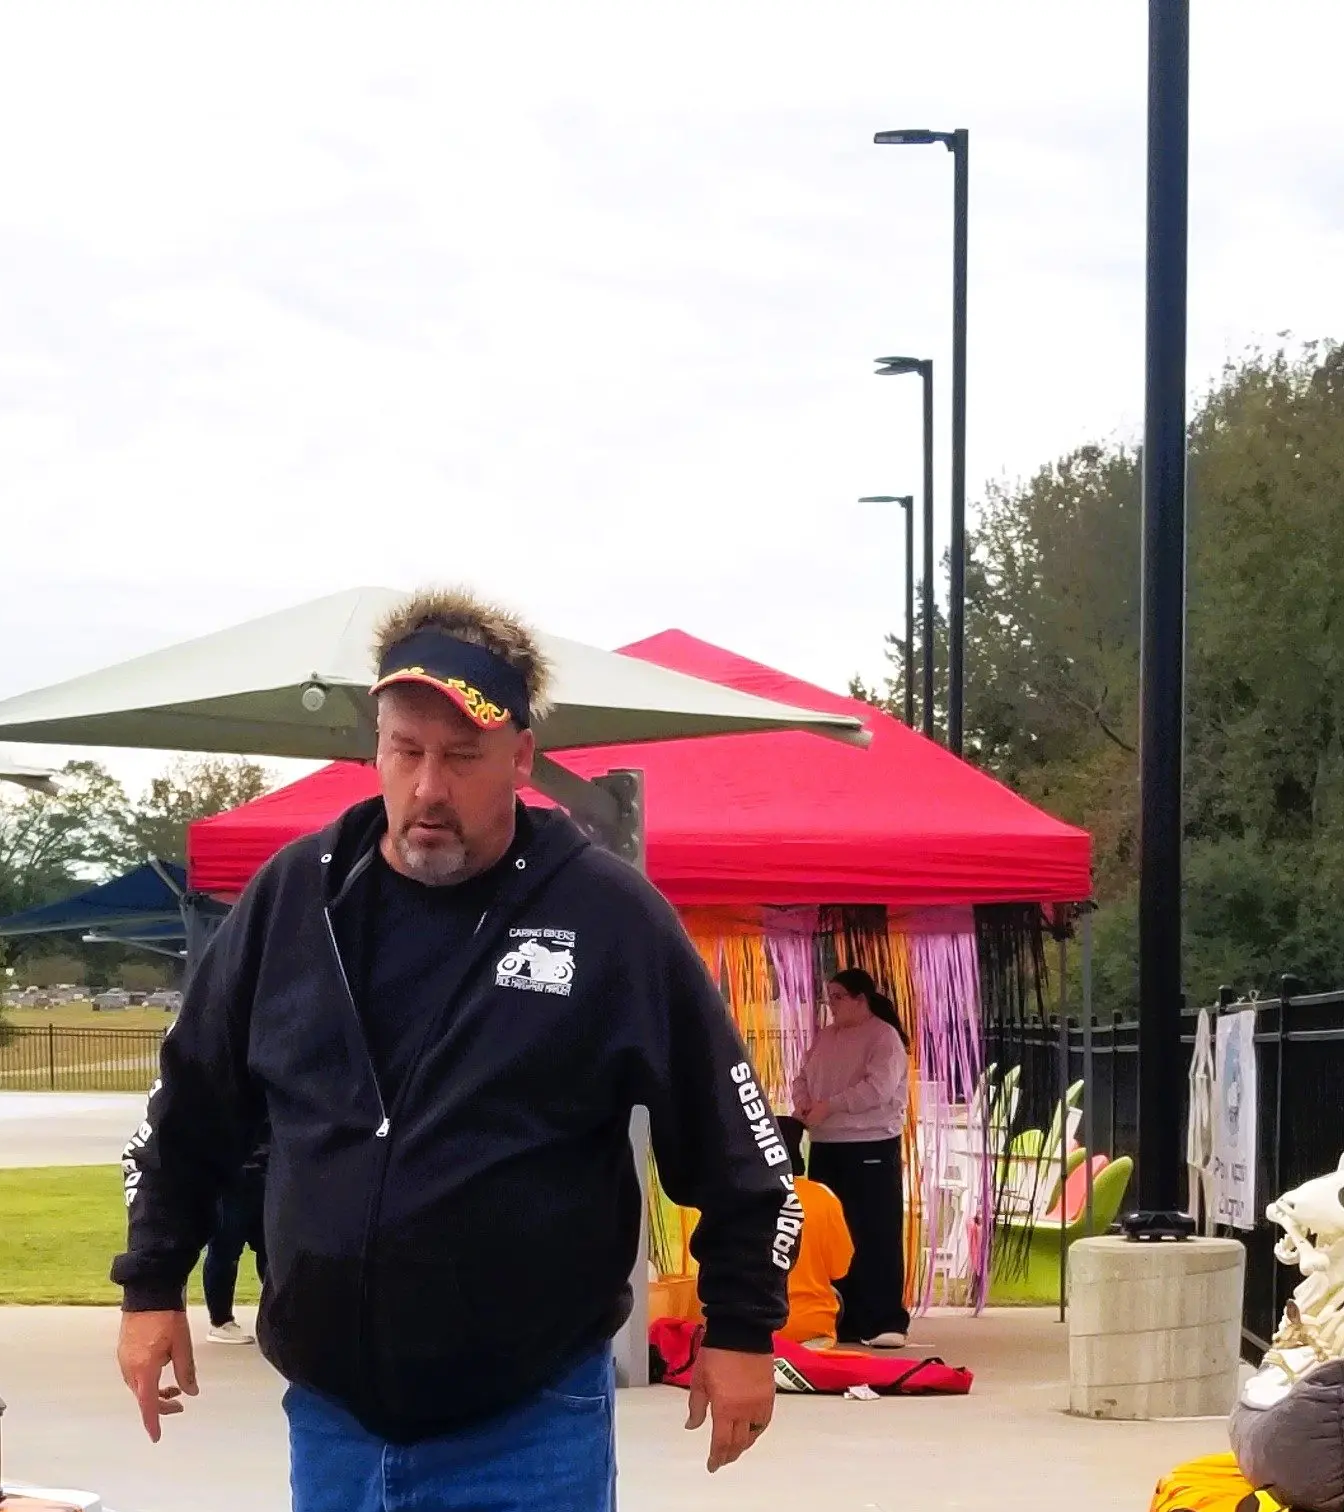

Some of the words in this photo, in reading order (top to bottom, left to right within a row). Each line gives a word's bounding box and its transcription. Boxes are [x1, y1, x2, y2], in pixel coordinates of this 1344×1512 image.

[509, 928, 542, 938] CARING
[543, 929, 576, 941] BIKERS
[730, 1061, 788, 1167] BIKERS
